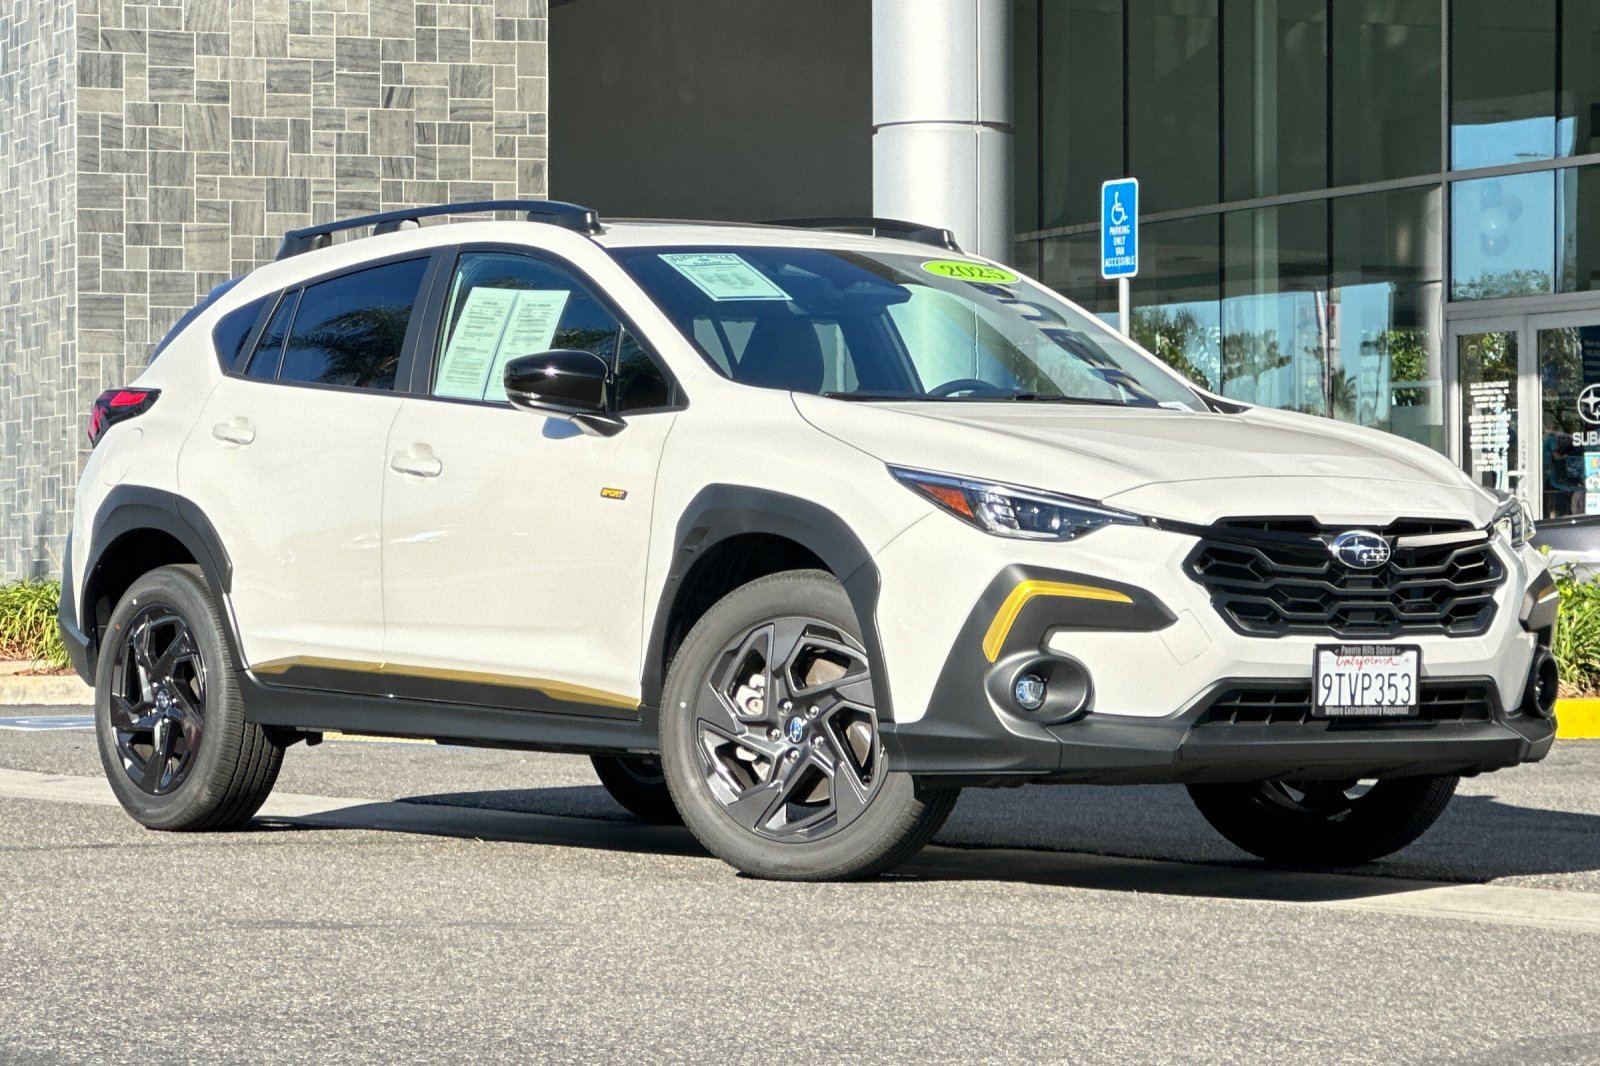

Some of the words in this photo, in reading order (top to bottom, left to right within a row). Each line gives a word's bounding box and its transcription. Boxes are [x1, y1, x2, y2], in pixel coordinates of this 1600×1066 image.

[1109, 225, 1131, 236] PARKING
[1113, 235, 1127, 246] ONLY
[1115, 246, 1126, 256] VAN
[1104, 255, 1135, 268] ACCESSIBLE
[940, 265, 1006, 280] 2025
[1572, 431, 1600, 447] SUB
[601, 488, 625, 499] SPORT
[1341, 646, 1361, 655] Puente
[1362, 646, 1375, 655] Hills
[1376, 646, 1396, 655] Subaru
[1336, 655, 1400, 671] California
[1322, 673, 1411, 706] 9TVP353
[1325, 706, 1344, 715] Where
[1344, 706, 1382, 716] Extraordinary
